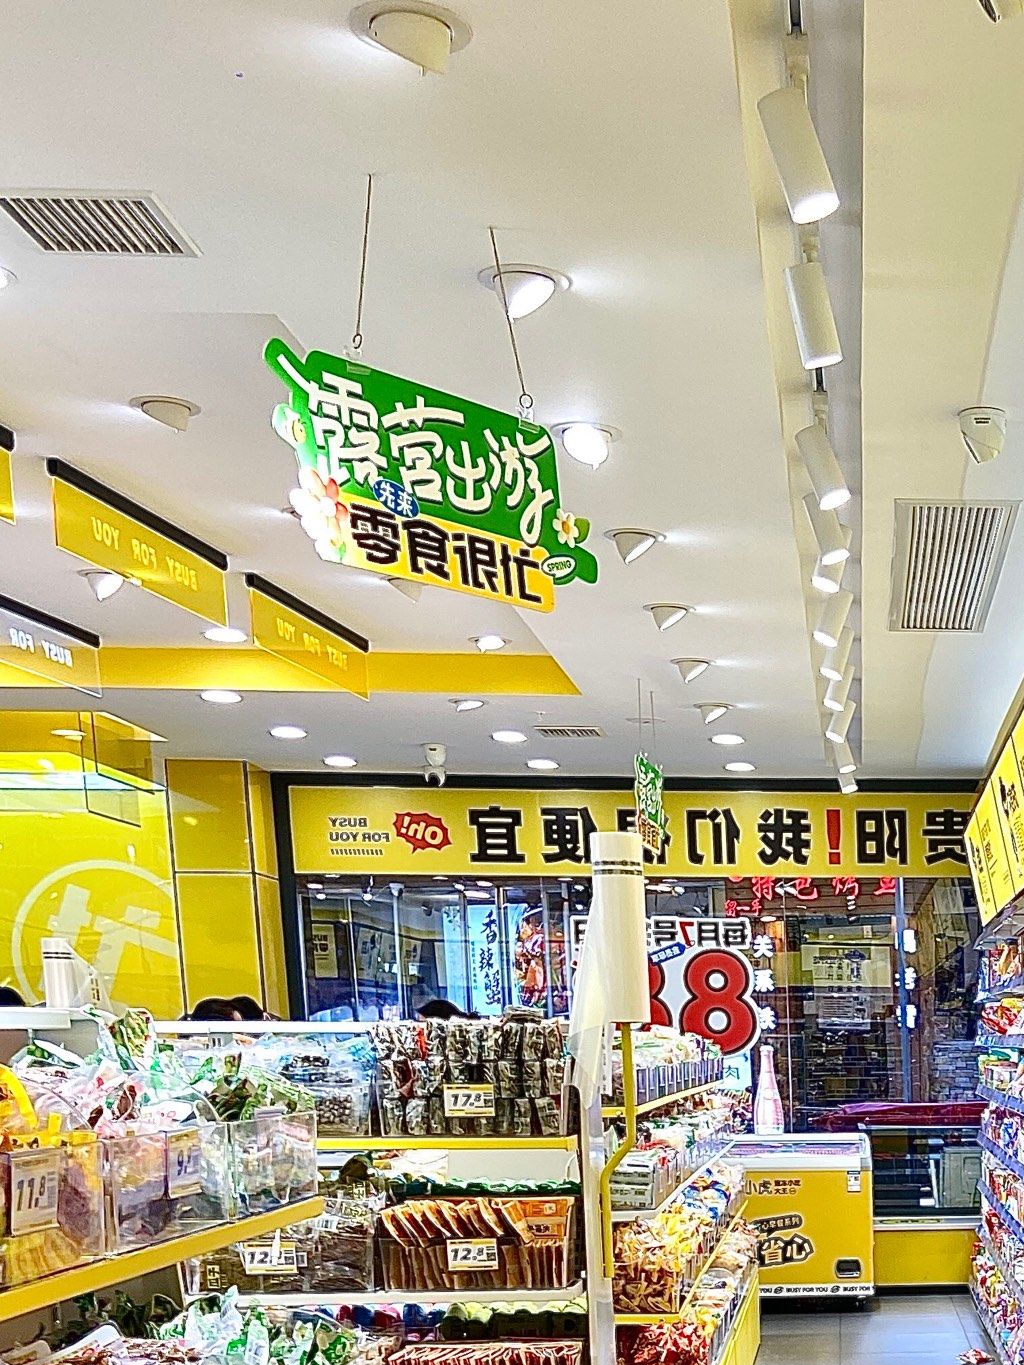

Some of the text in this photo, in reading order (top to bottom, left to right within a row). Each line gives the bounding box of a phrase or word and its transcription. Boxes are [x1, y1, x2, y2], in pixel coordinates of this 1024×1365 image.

[350, 502, 543, 604] 零食很忙
[546, 560, 572, 573] SPRING
[451, 1092, 482, 1107] 17.8
[17, 1175, 47, 1212] 11.8
[451, 1247, 484, 1261] 12.8
[761, 1235, 811, 1264] 省心
